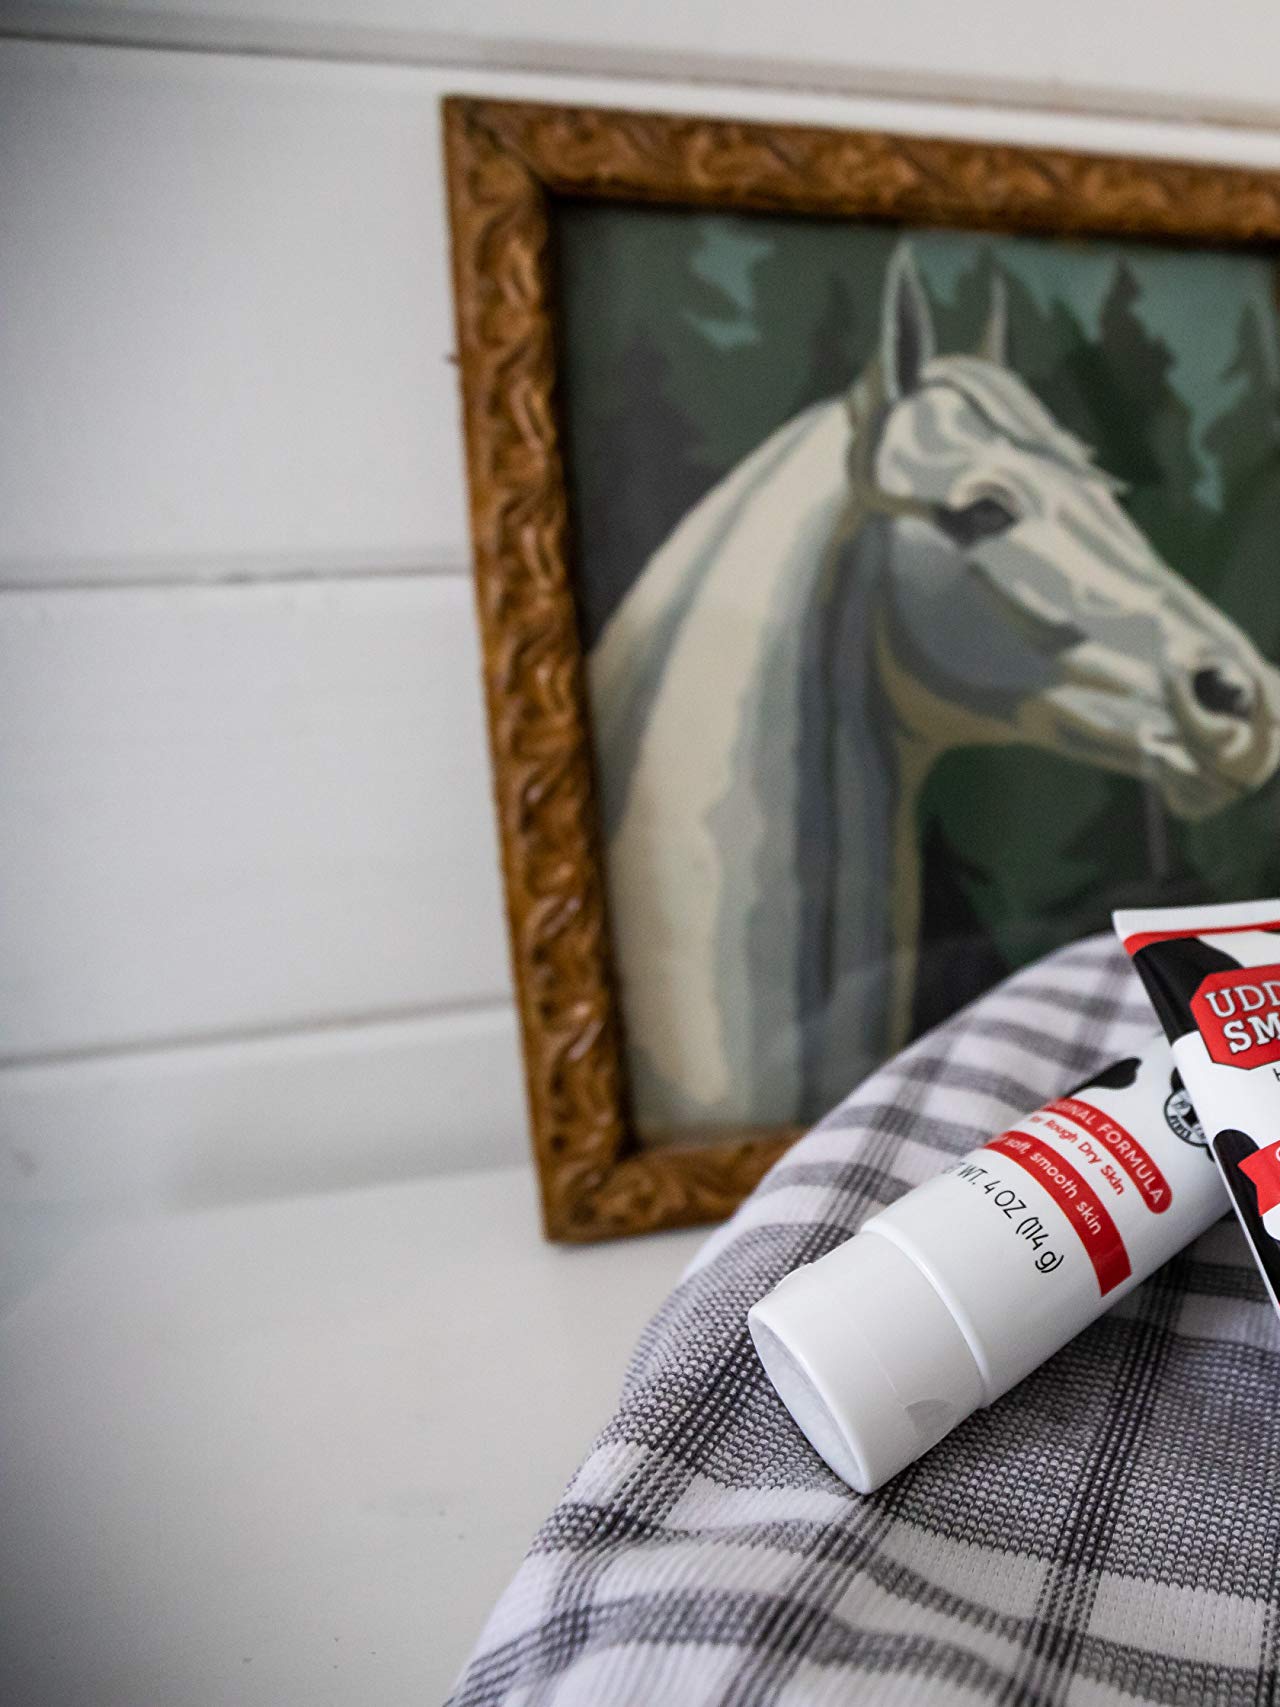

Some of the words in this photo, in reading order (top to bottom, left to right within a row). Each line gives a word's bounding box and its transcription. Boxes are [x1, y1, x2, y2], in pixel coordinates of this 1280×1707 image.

[957, 1165, 988, 1185] WT.
[984, 1180, 1001, 1195] 4
[994, 1190, 1027, 1219] OZ
[1004, 1138, 1032, 1155] soft,
[1029, 1152, 1078, 1199] smooth
[1075, 1201, 1102, 1235] skin
[1044, 1119, 1078, 1143] Rough
[1078, 1141, 1102, 1165] Dry
[1100, 1164, 1125, 1196] Skin
[1097, 1123, 1164, 1204] FORMULA
